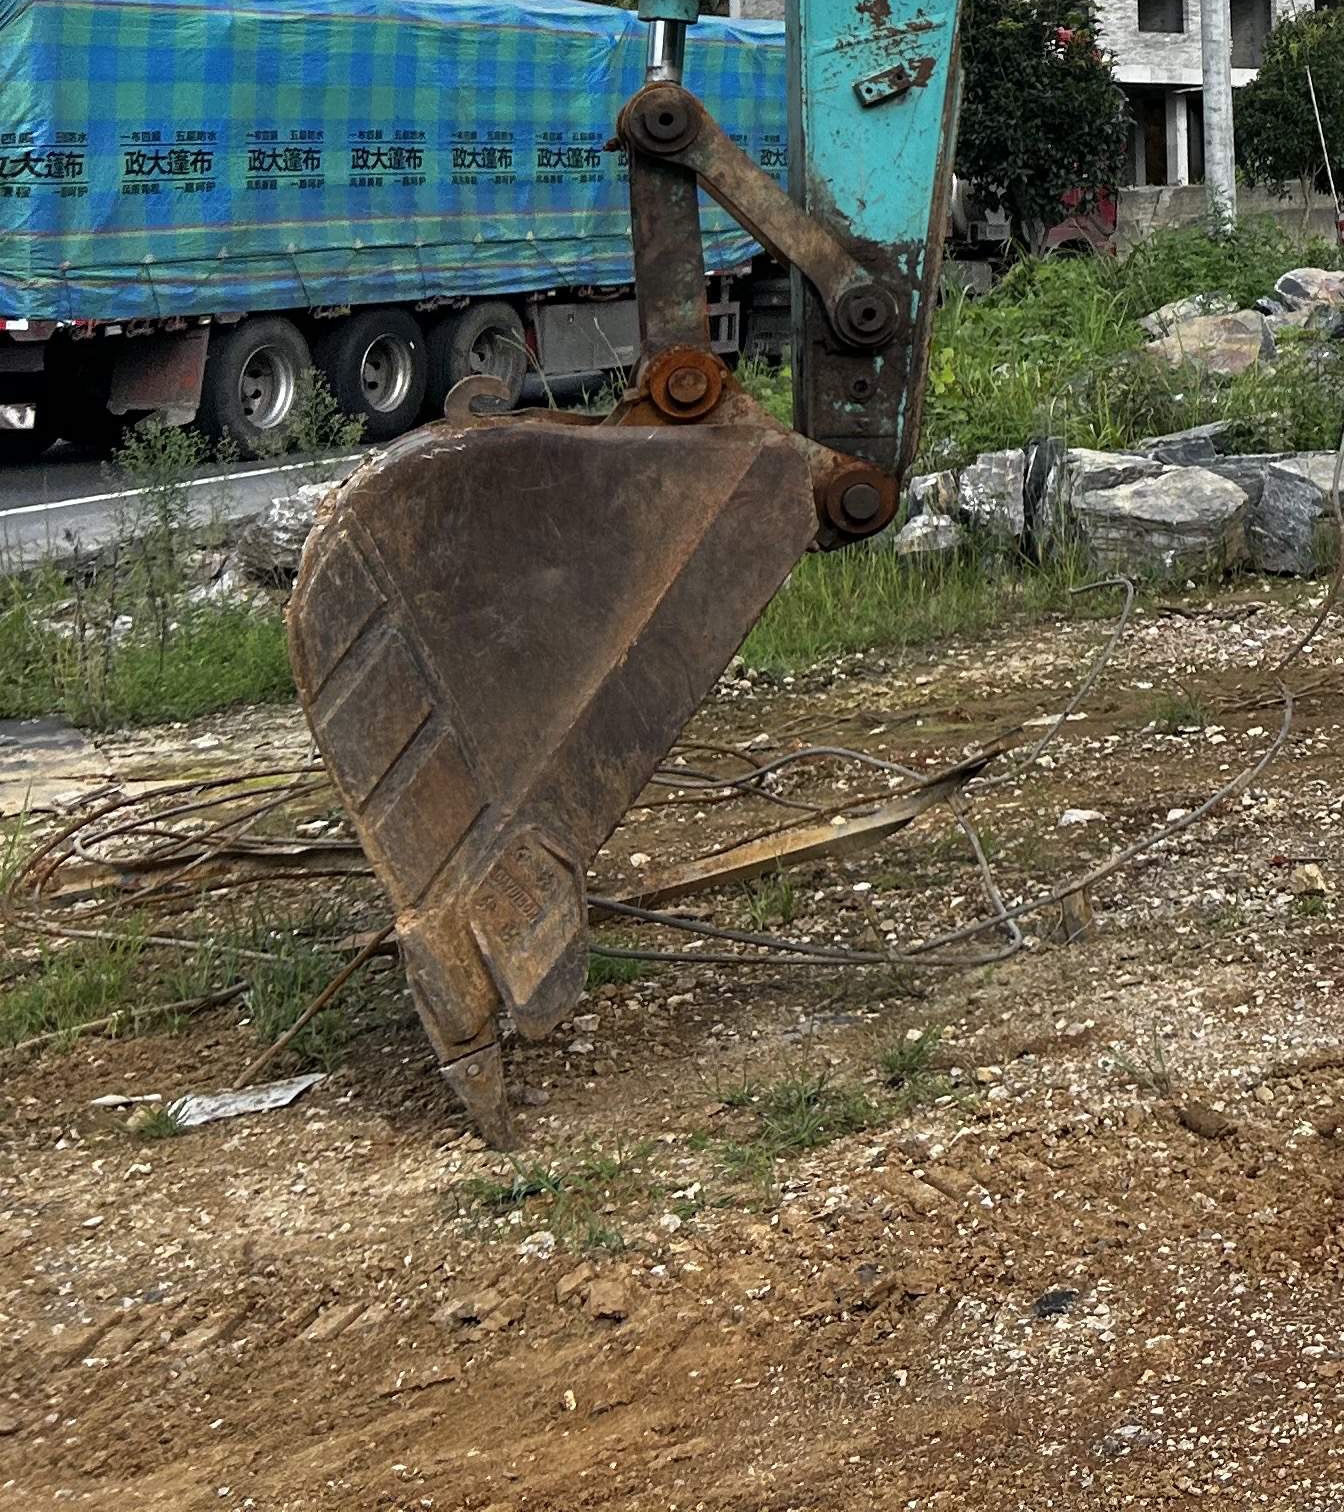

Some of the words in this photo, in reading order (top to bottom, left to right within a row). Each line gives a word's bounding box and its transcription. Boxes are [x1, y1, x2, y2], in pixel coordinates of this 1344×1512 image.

[123, 148, 215, 177] 政大篷布
[247, 146, 321, 172] 政大篷布
[351, 146, 425, 171] 政大篷布
